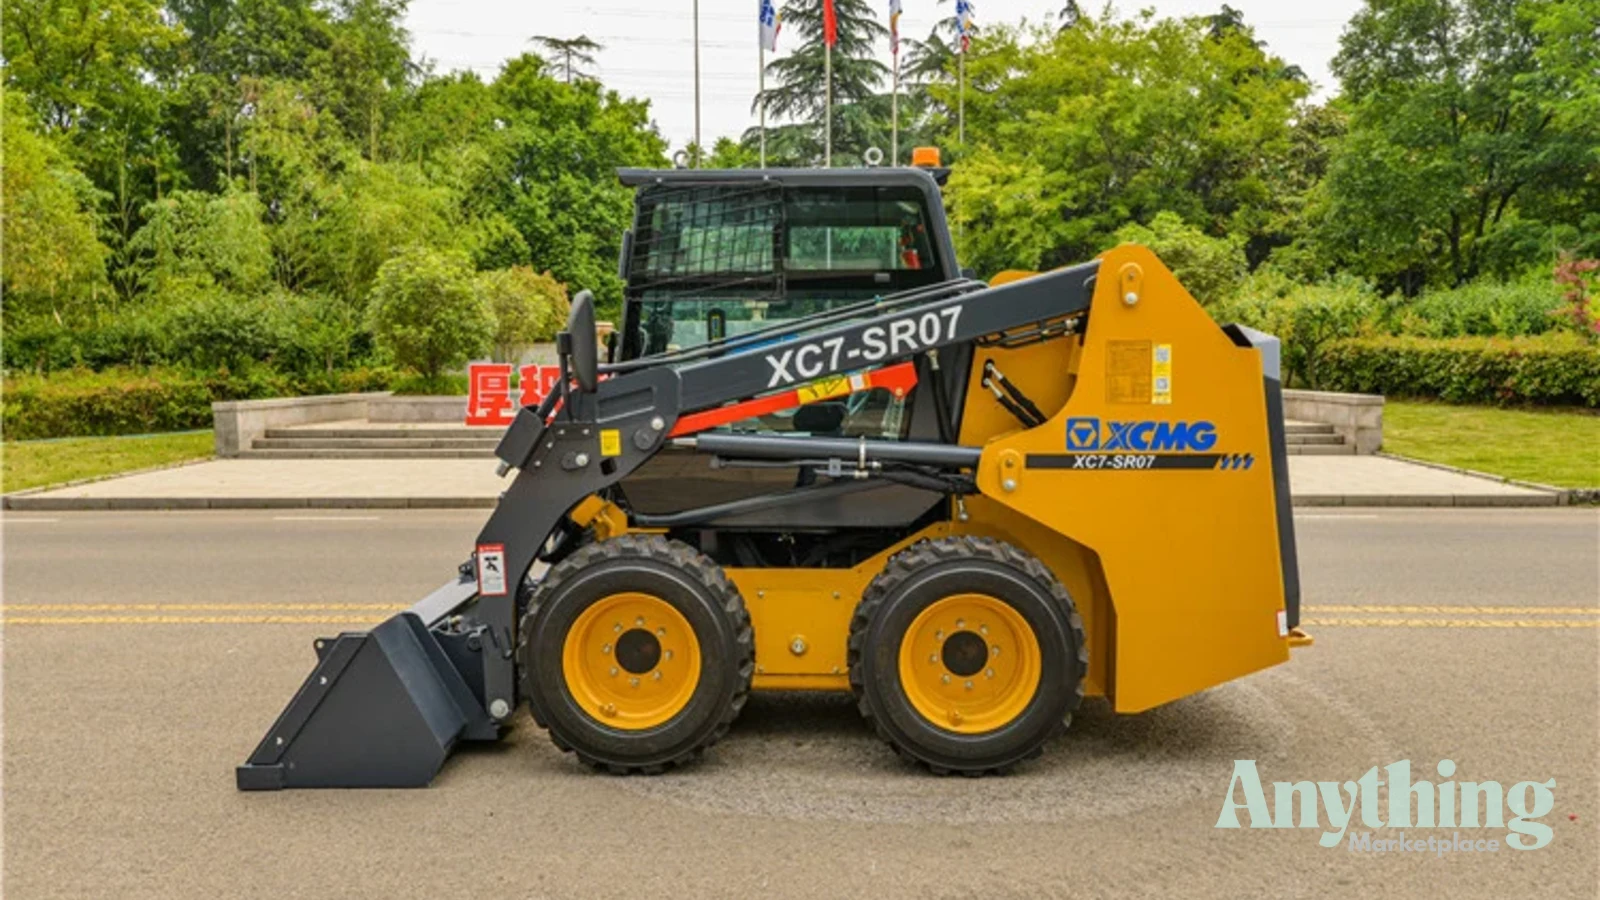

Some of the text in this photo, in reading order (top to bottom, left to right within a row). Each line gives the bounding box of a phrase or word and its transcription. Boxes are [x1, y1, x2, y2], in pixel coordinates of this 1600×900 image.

[765, 305, 963, 388] XC7-SR07
[1102, 420, 1217, 450] XCMG
[1073, 455, 1156, 469] XC7-SR07
